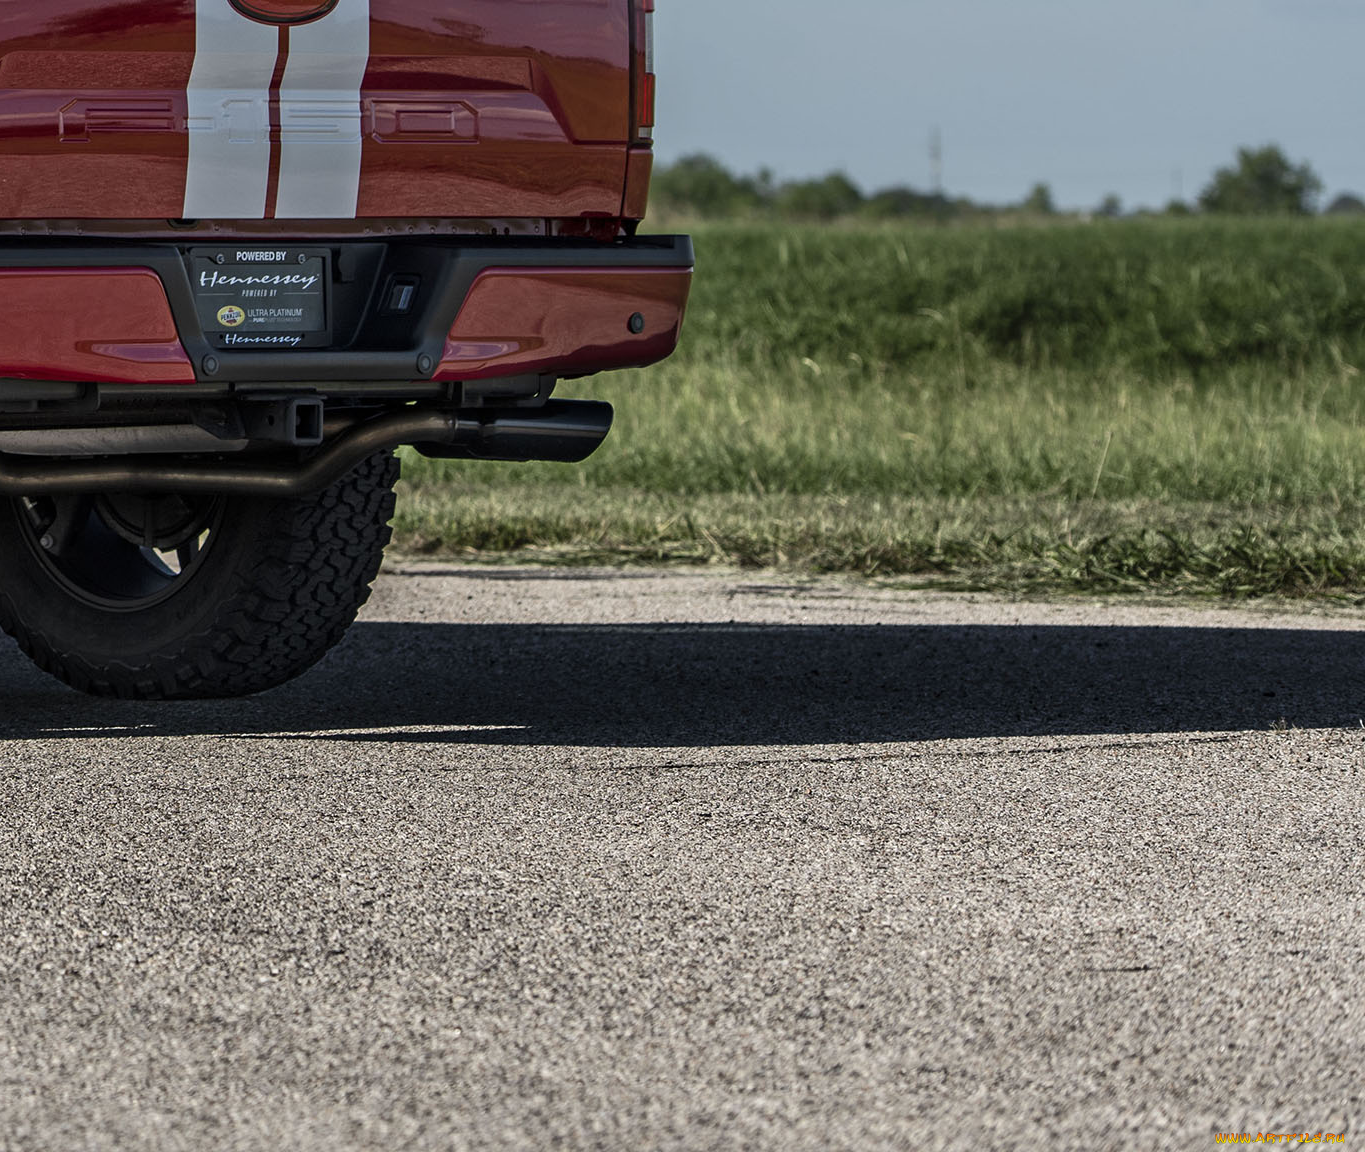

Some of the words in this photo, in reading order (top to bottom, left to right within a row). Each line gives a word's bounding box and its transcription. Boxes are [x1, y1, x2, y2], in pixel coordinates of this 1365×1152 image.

[236, 251, 274, 261] POWERED
[275, 251, 287, 261] BY
[199, 271, 319, 289] Hennessey
[247, 308, 268, 317] ULTRA
[225, 333, 301, 346] Hennessey
